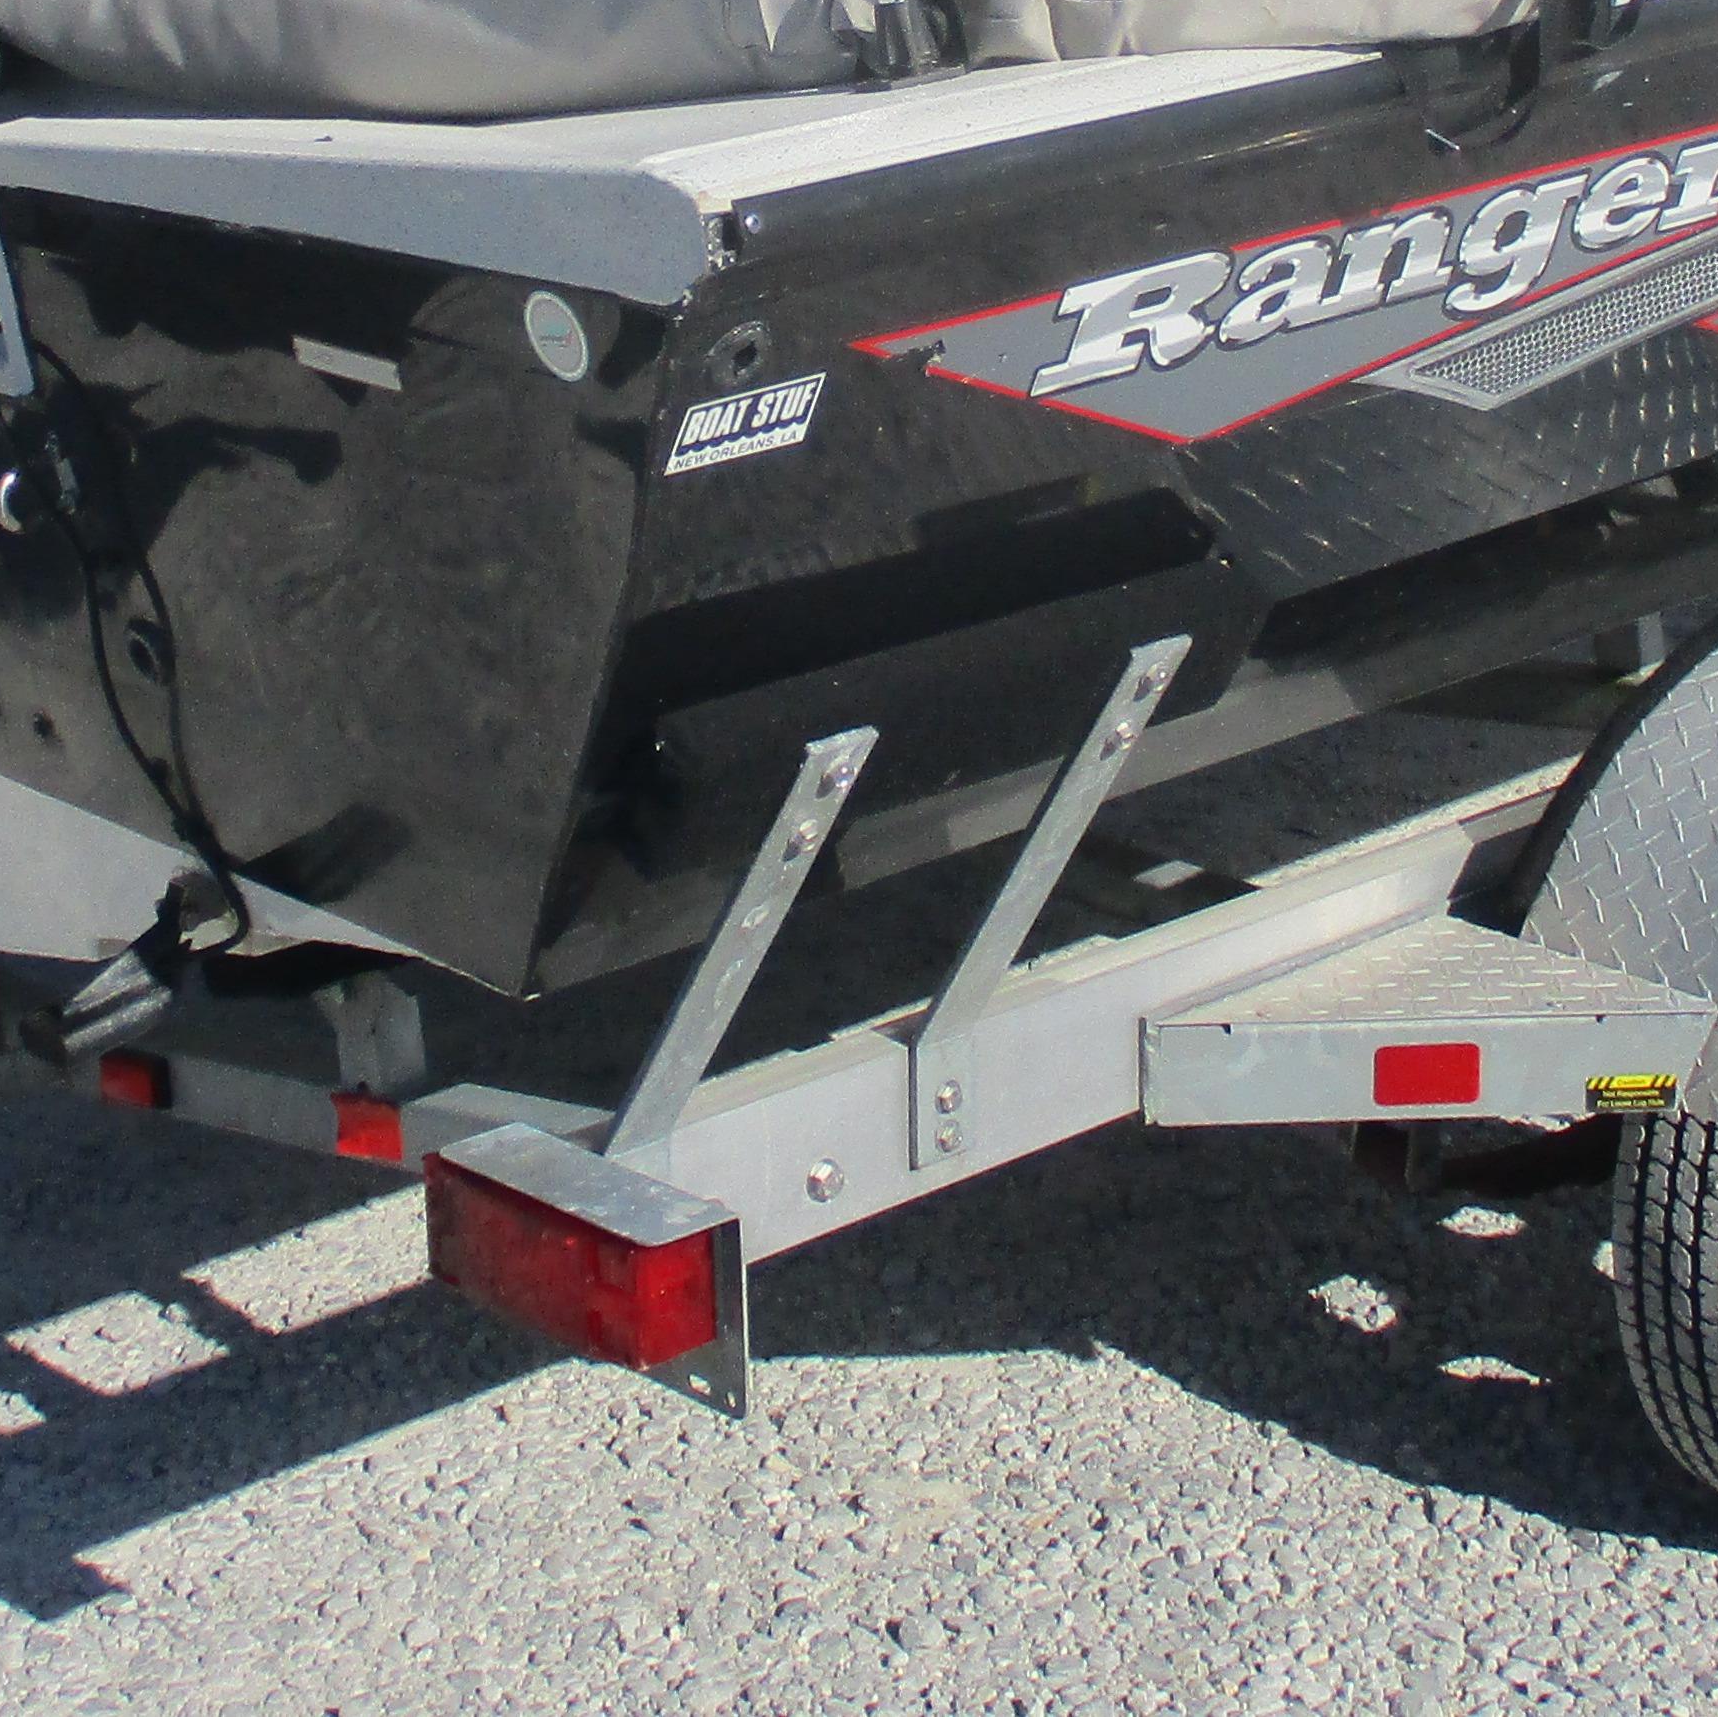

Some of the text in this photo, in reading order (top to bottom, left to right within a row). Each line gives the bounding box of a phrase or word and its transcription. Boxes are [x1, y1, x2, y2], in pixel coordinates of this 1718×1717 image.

[681, 380, 819, 447] BOAT STUF
[673, 452, 708, 470] NEW
[779, 429, 798, 444] LA
